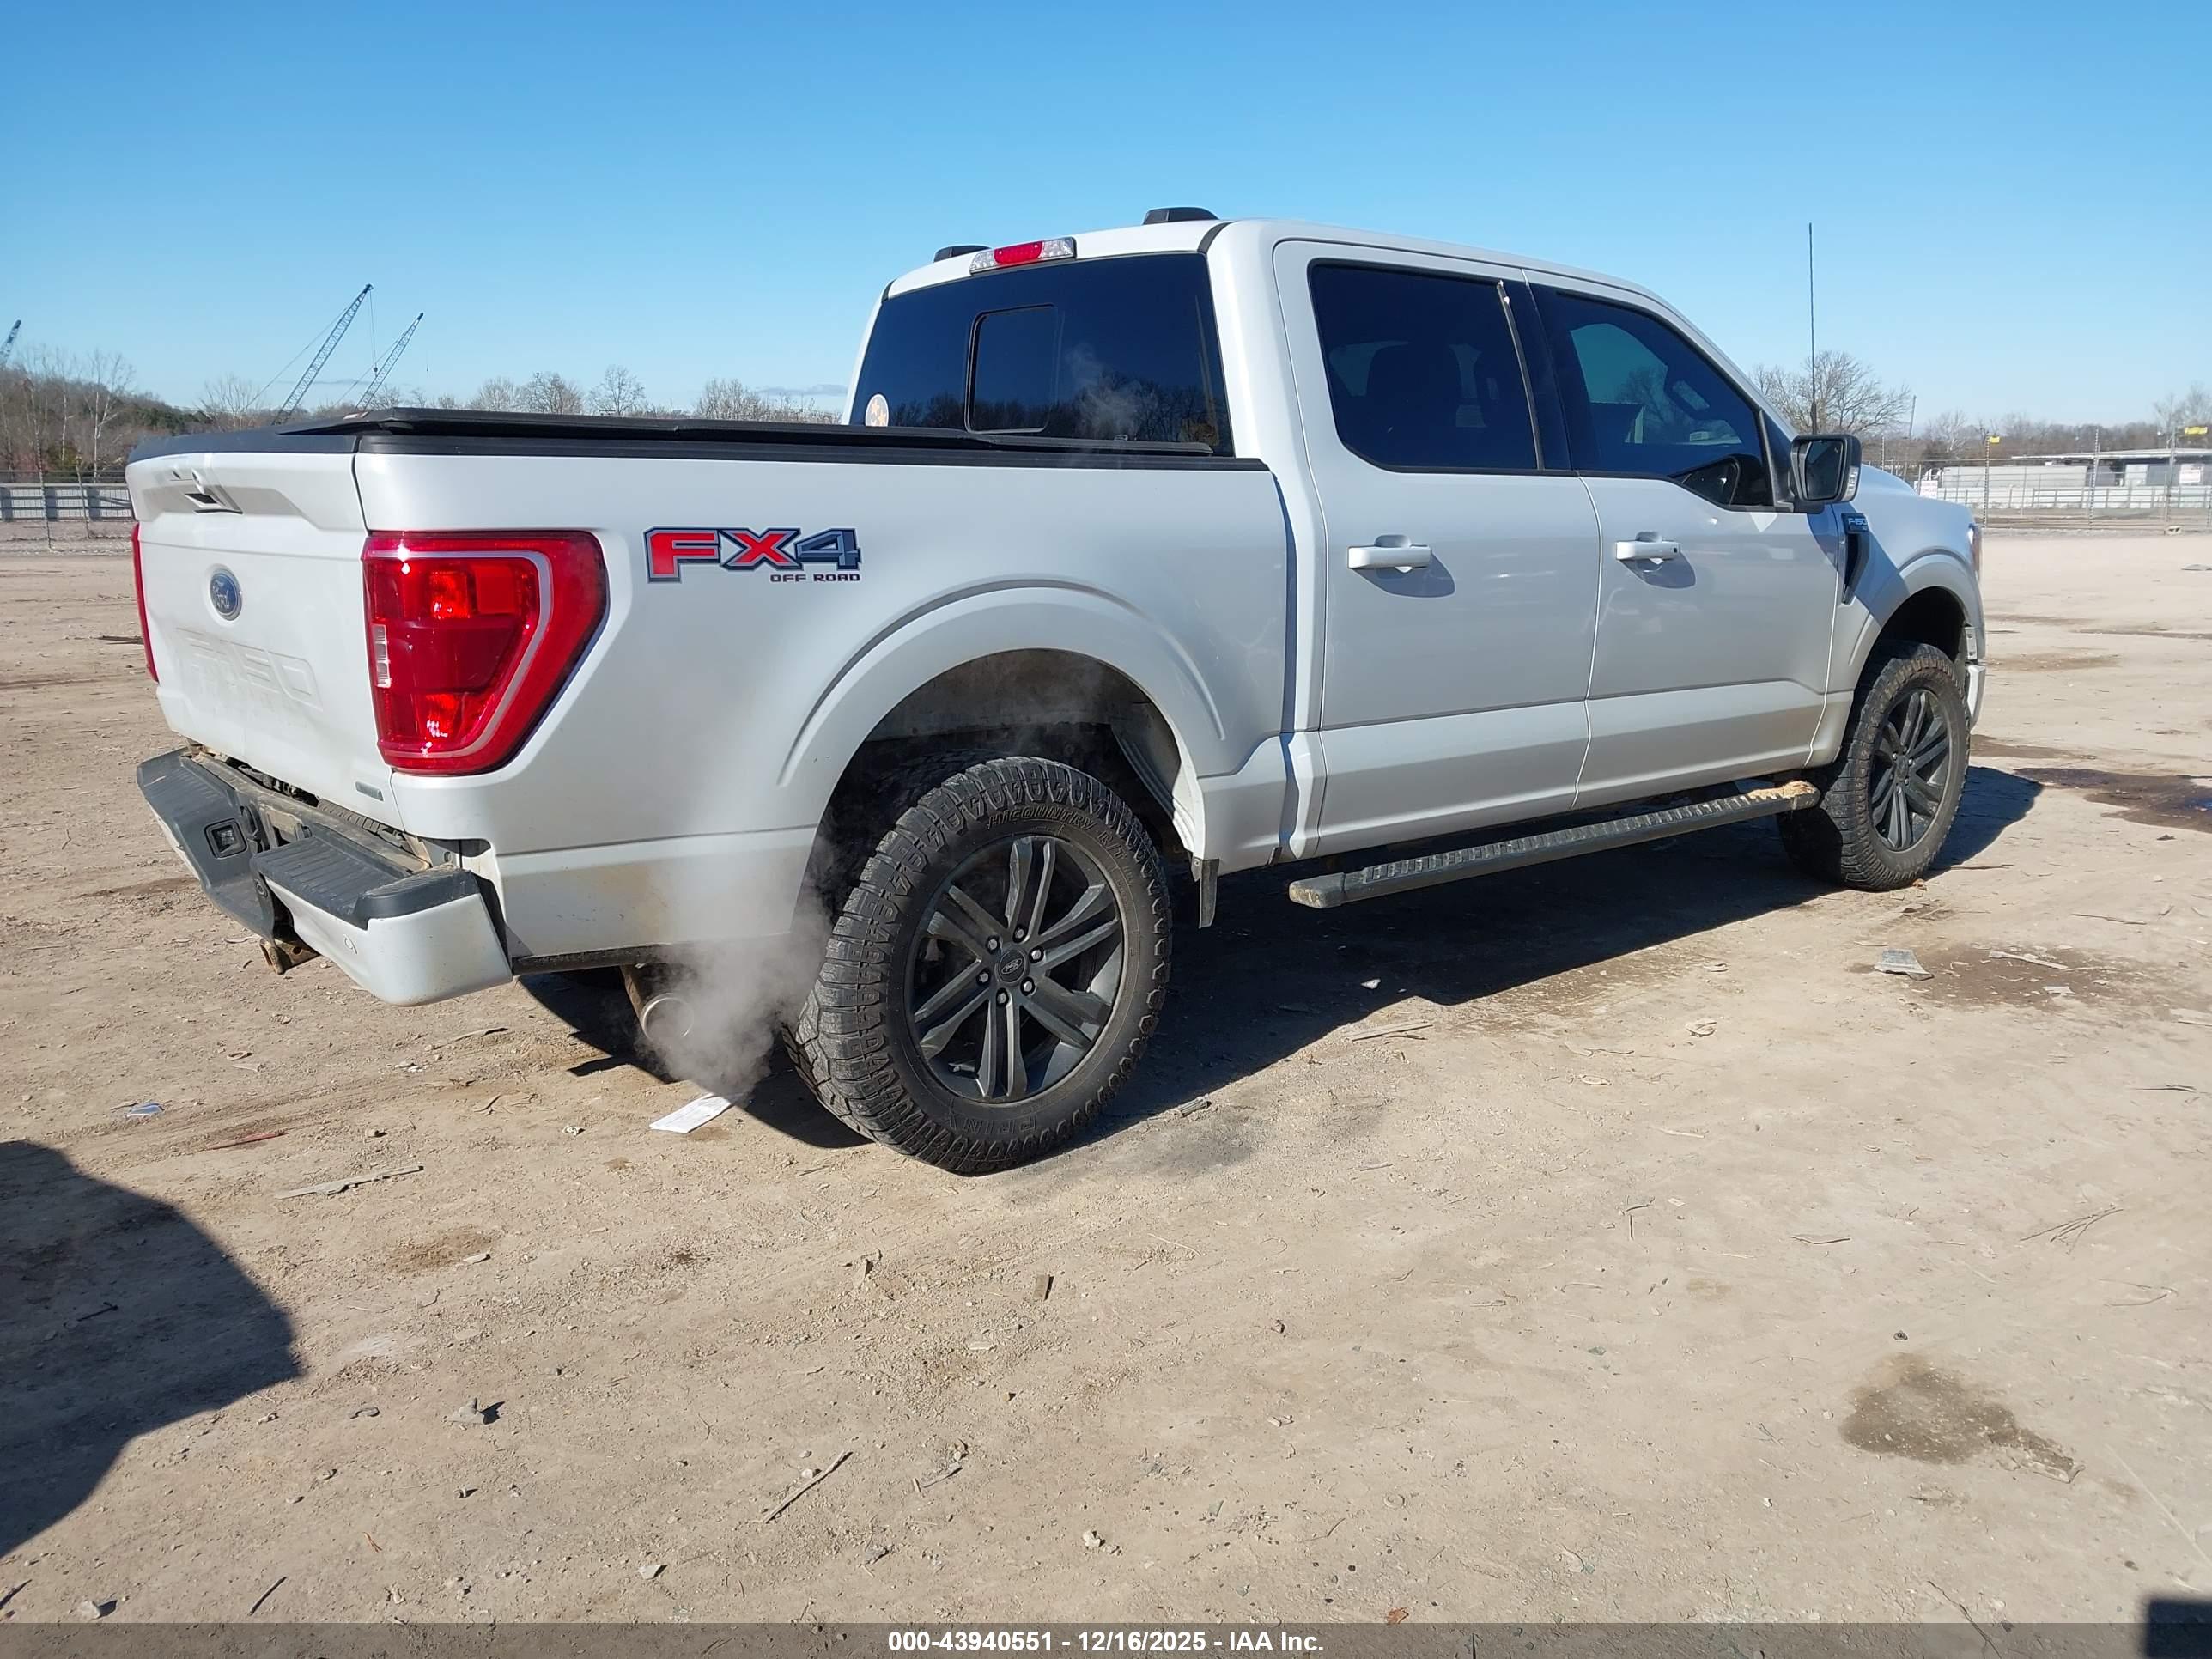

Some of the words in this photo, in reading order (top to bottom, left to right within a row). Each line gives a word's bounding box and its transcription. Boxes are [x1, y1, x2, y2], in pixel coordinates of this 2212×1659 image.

[644, 527, 860, 583] FX4
[769, 574, 806, 583] OFF
[813, 573, 860, 583] ROAD
